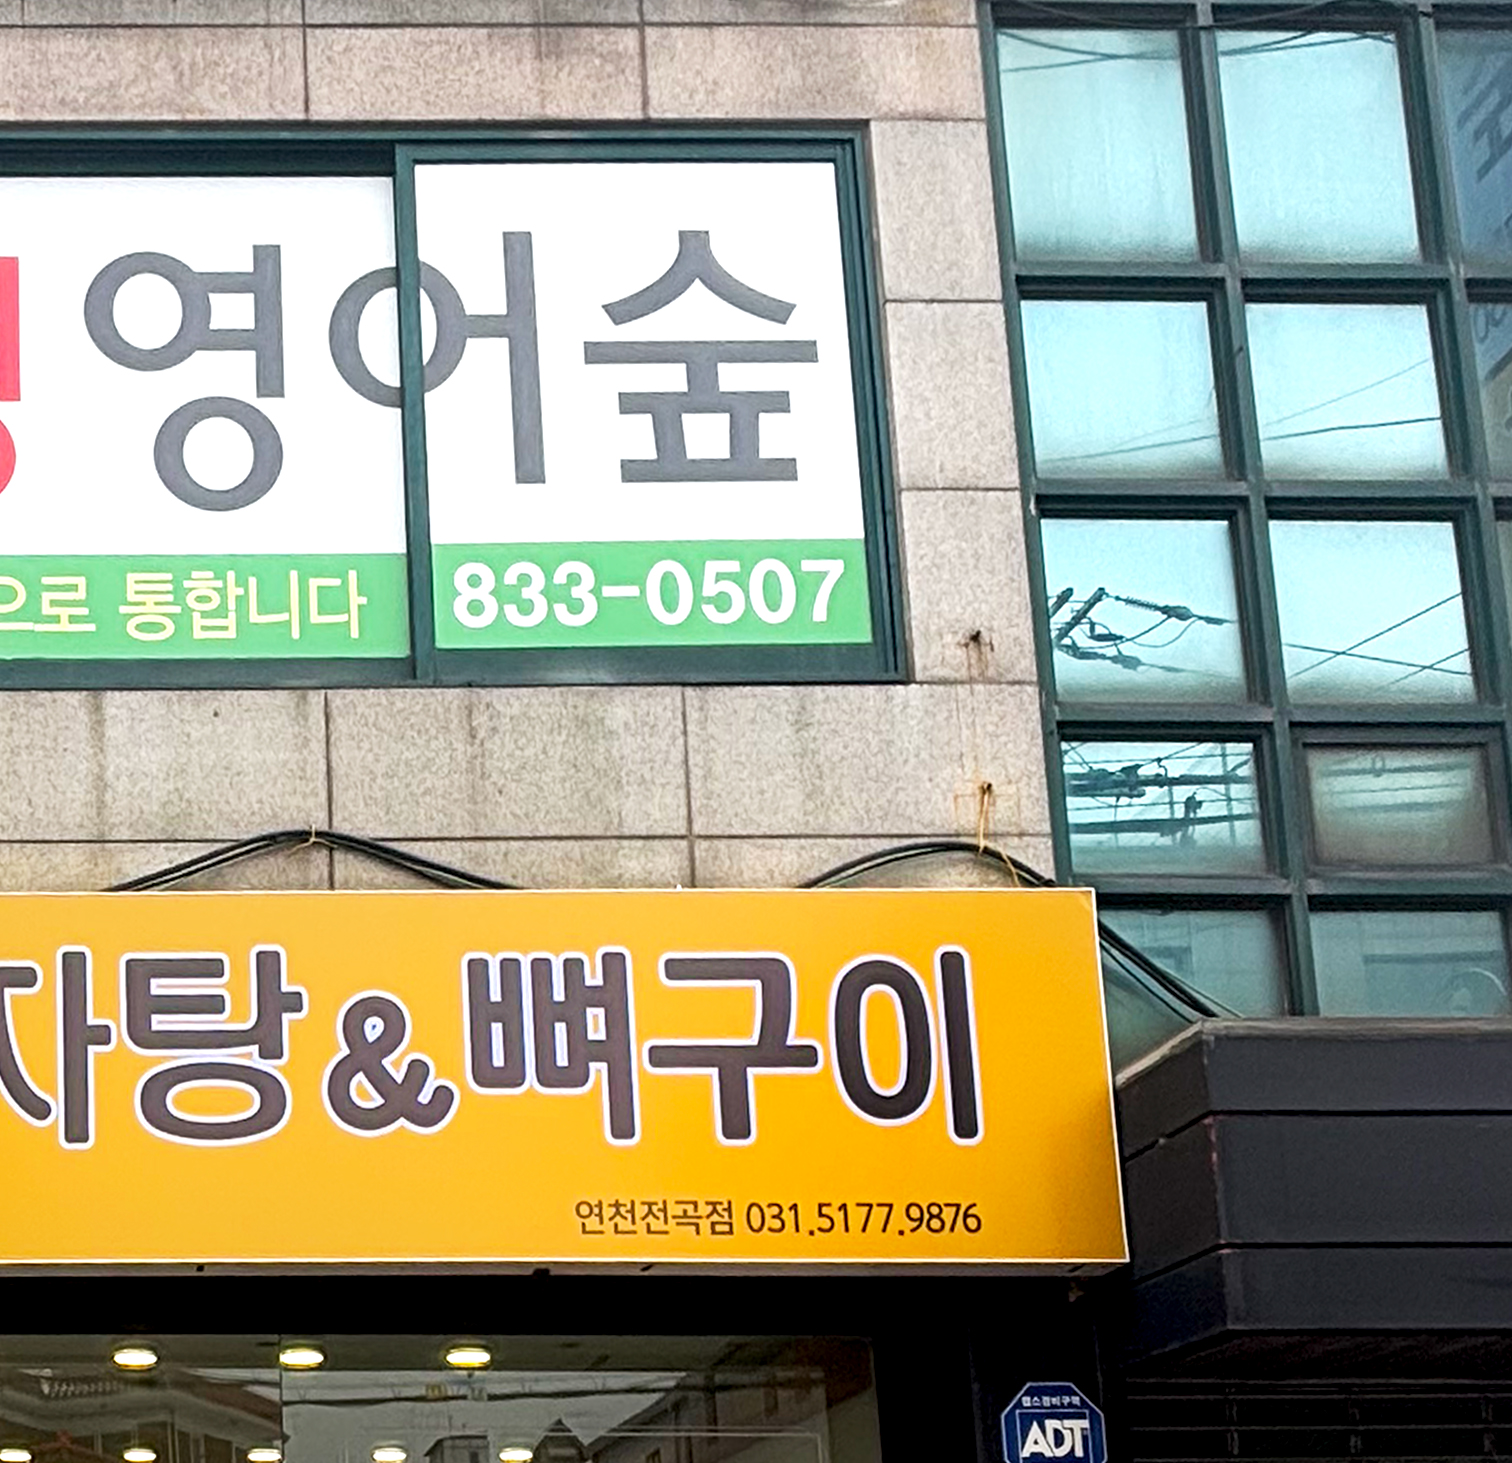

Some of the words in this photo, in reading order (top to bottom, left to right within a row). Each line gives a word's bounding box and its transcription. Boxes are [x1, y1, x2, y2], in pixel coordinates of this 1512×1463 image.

[84, 229, 819, 512] 영어숲
[118, 567, 368, 641] 통합니다
[451, 557, 846, 629] 833-0507
[574, 1200, 735, 1237] 연천전곡점
[745, 1201, 982, 1238] 031.5177.9876
[1020, 1418, 1090, 1458] ADT
